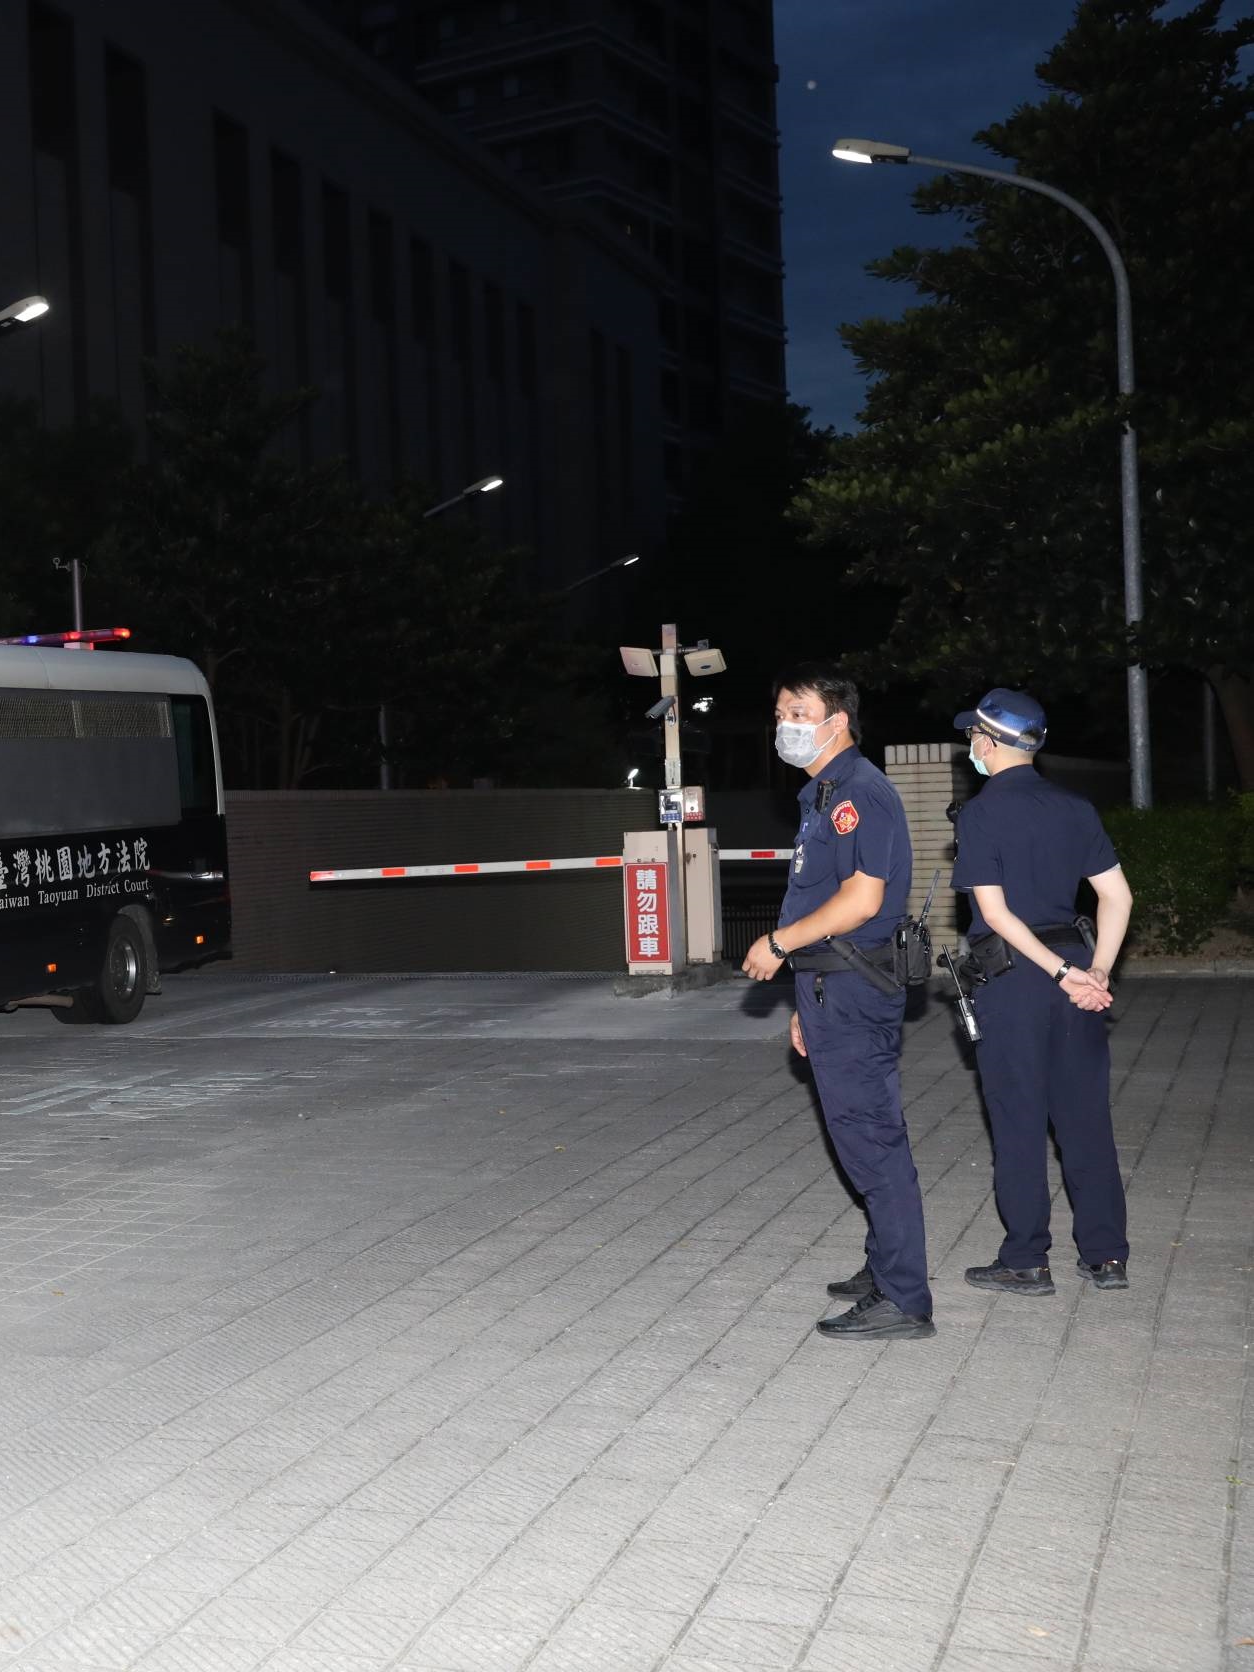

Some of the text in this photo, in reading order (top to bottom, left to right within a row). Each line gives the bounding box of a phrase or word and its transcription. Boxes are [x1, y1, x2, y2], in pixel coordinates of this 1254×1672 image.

[38, 888, 79, 907] Taoyuan
[86, 881, 120, 899] District
[124, 878, 149, 893] Court
[635, 868, 660, 958] 請勿跟車
